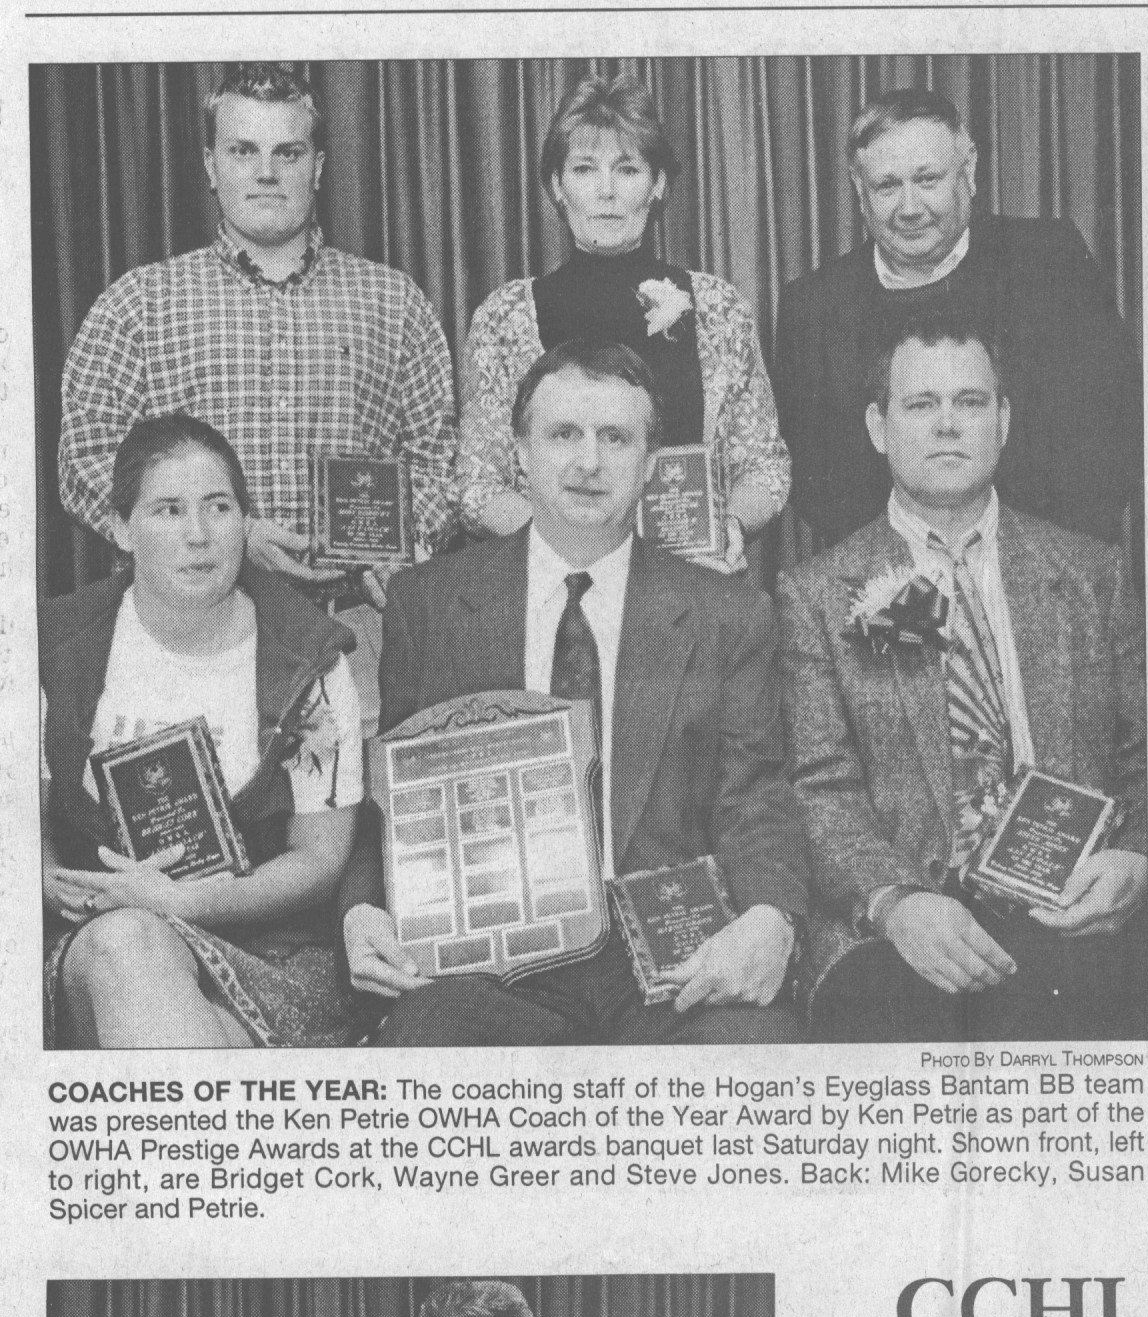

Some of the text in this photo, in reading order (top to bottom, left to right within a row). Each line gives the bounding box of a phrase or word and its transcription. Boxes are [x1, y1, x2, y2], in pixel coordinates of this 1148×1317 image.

[921, 1050, 1143, 1068] PHOTO BY DARRYL THOMPSON
[48, 1073, 1143, 1104] COACHES OF THE YEAR: The coaching staff of the Hogan's Eyeglass Bantam BB team
[48, 1160, 1144, 1196] to right, are Bridget Cork, Wayne Greer and Steve Jones. Back: Mike Gorecky, Susan
[50, 1197, 264, 1225] Spicer and Petrie.
